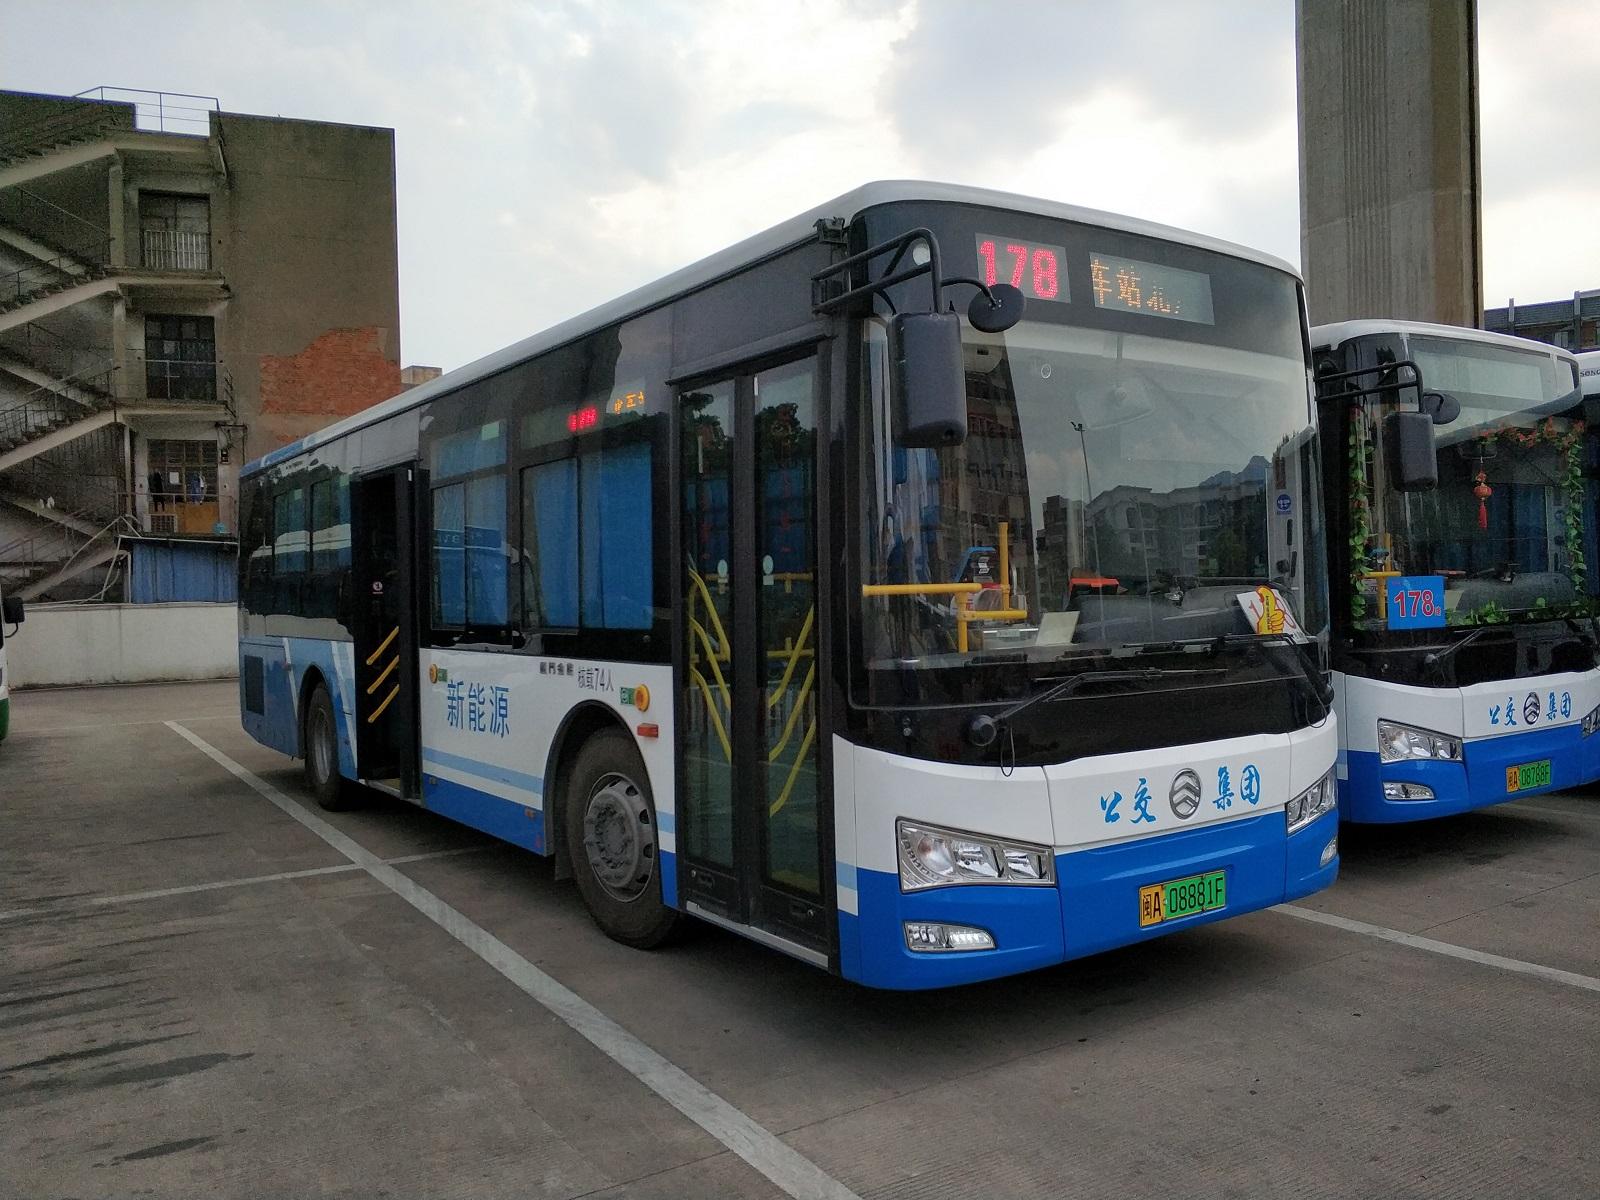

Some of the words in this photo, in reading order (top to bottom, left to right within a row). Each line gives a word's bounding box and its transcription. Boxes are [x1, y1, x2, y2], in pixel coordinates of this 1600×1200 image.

[979, 240, 1058, 299] 178
[447, 680, 510, 738] 新能源
[1489, 697, 1517, 726] 公交
[1546, 691, 1572, 719] 集团
[1101, 778, 1157, 824] 公交
[1213, 764, 1260, 811] 集团
